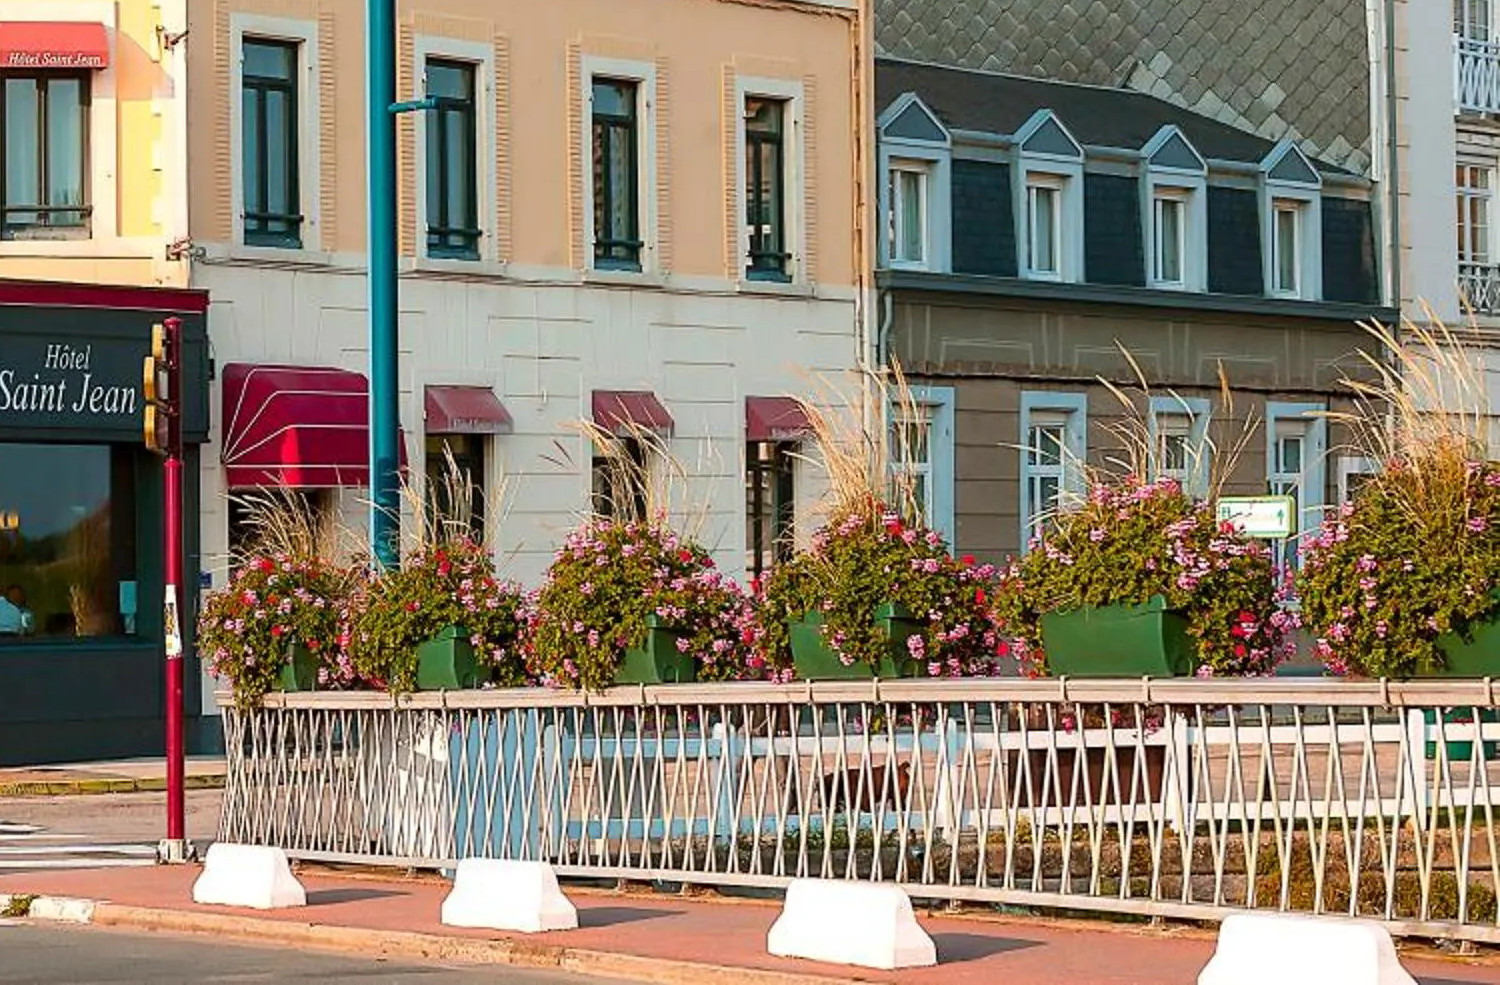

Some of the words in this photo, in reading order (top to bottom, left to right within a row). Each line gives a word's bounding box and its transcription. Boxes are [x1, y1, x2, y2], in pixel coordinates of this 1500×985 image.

[9, 52, 38, 65] Hôtel
[41, 52, 72, 65] Saint
[73, 53, 101, 66] Jean
[45, 344, 91, 370] Hôtel
[72, 372, 136, 414] Jean
